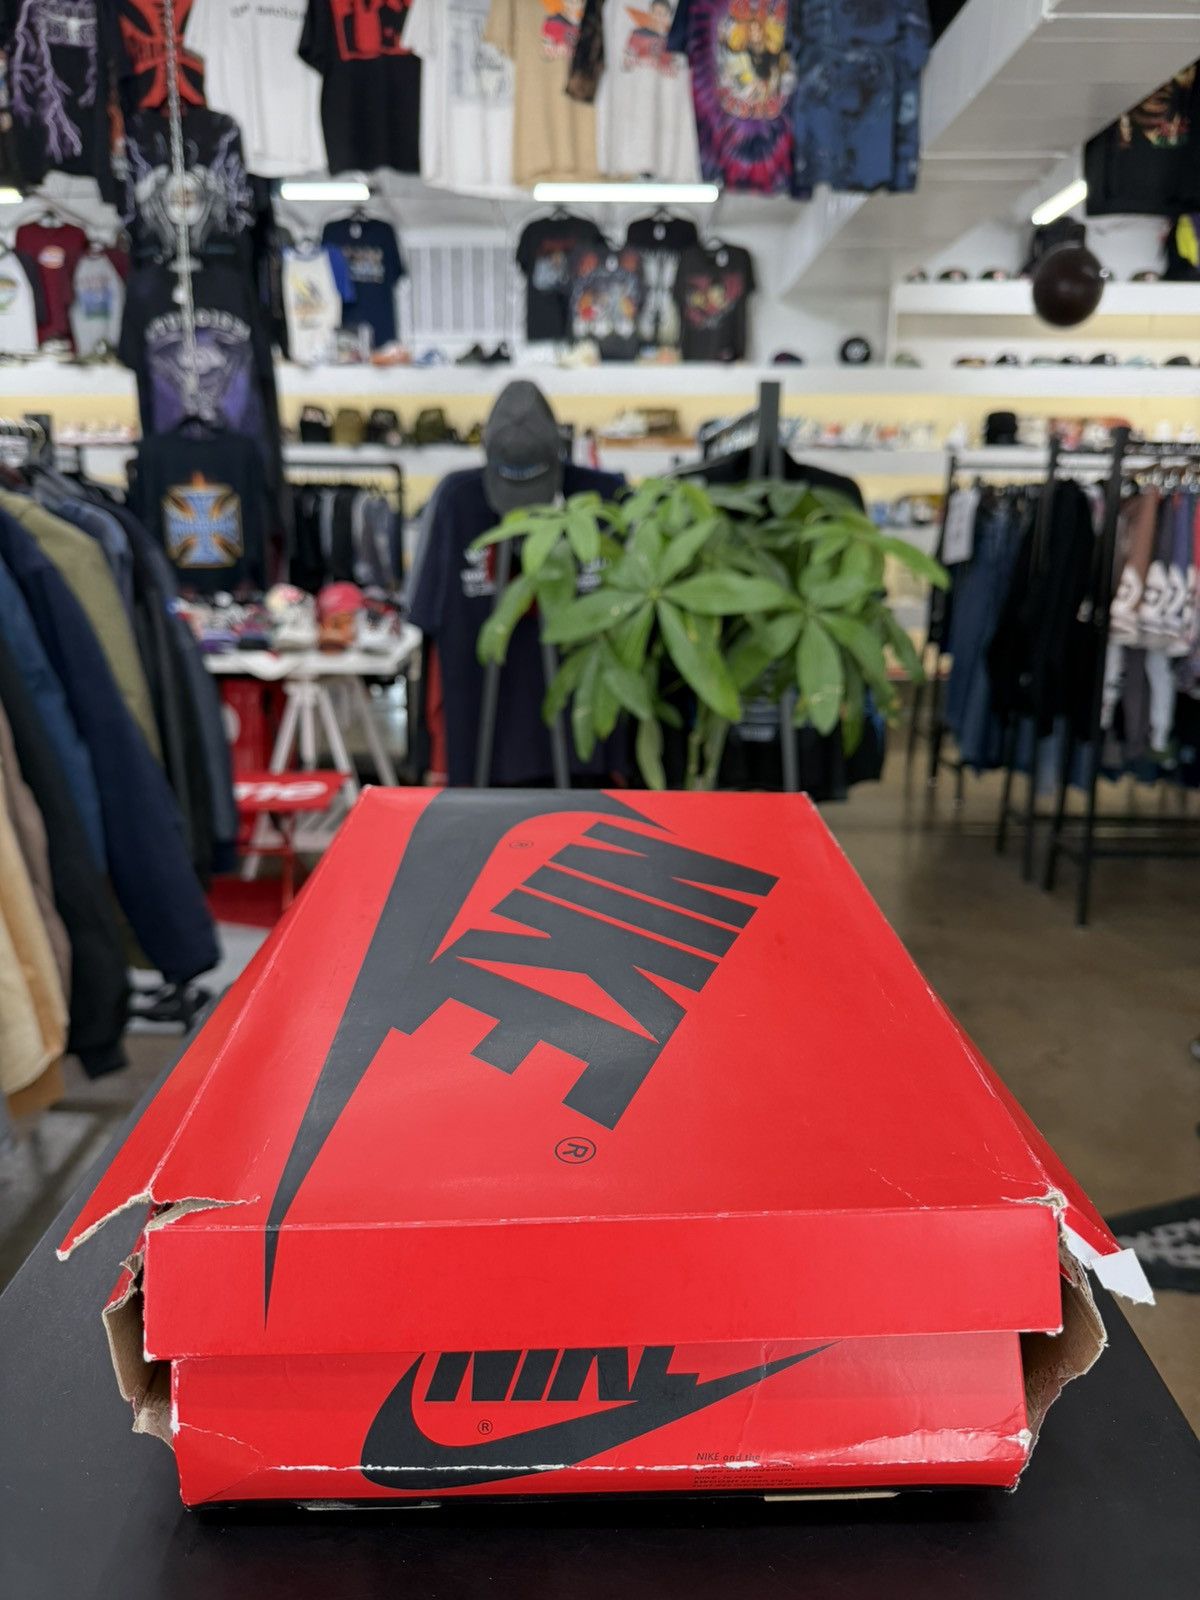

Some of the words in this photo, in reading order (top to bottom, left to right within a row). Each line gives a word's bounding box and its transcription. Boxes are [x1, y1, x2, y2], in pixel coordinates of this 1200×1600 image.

[391, 821, 780, 1130] NIKE
[696, 1452, 719, 1461] NIKE
[722, 1454, 742, 1462] and
